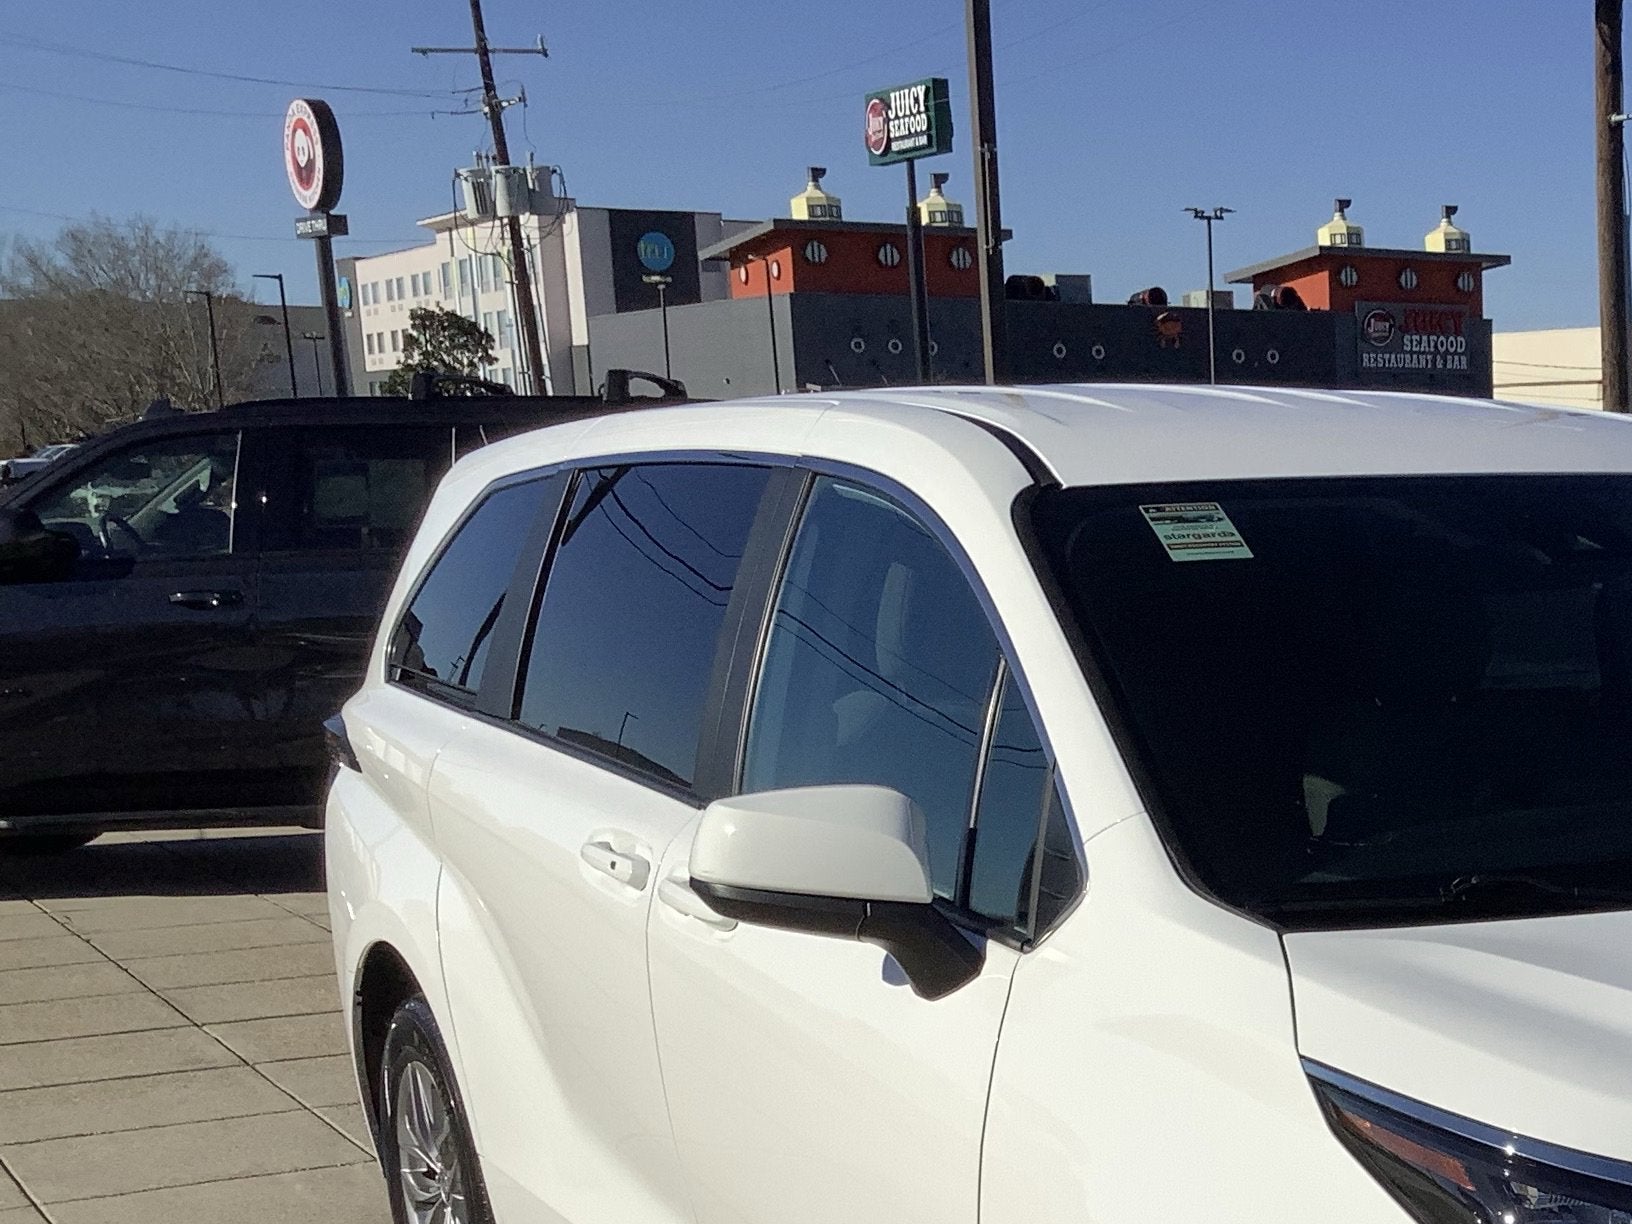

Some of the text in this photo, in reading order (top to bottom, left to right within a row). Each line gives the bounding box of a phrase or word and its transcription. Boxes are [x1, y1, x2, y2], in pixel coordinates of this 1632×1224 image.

[888, 84, 927, 119] JUICY
[889, 113, 927, 138] SEAFOOD
[1403, 335, 1466, 353] SEAFOOD
[1362, 353, 1468, 369] RESTAURANT & BAR
